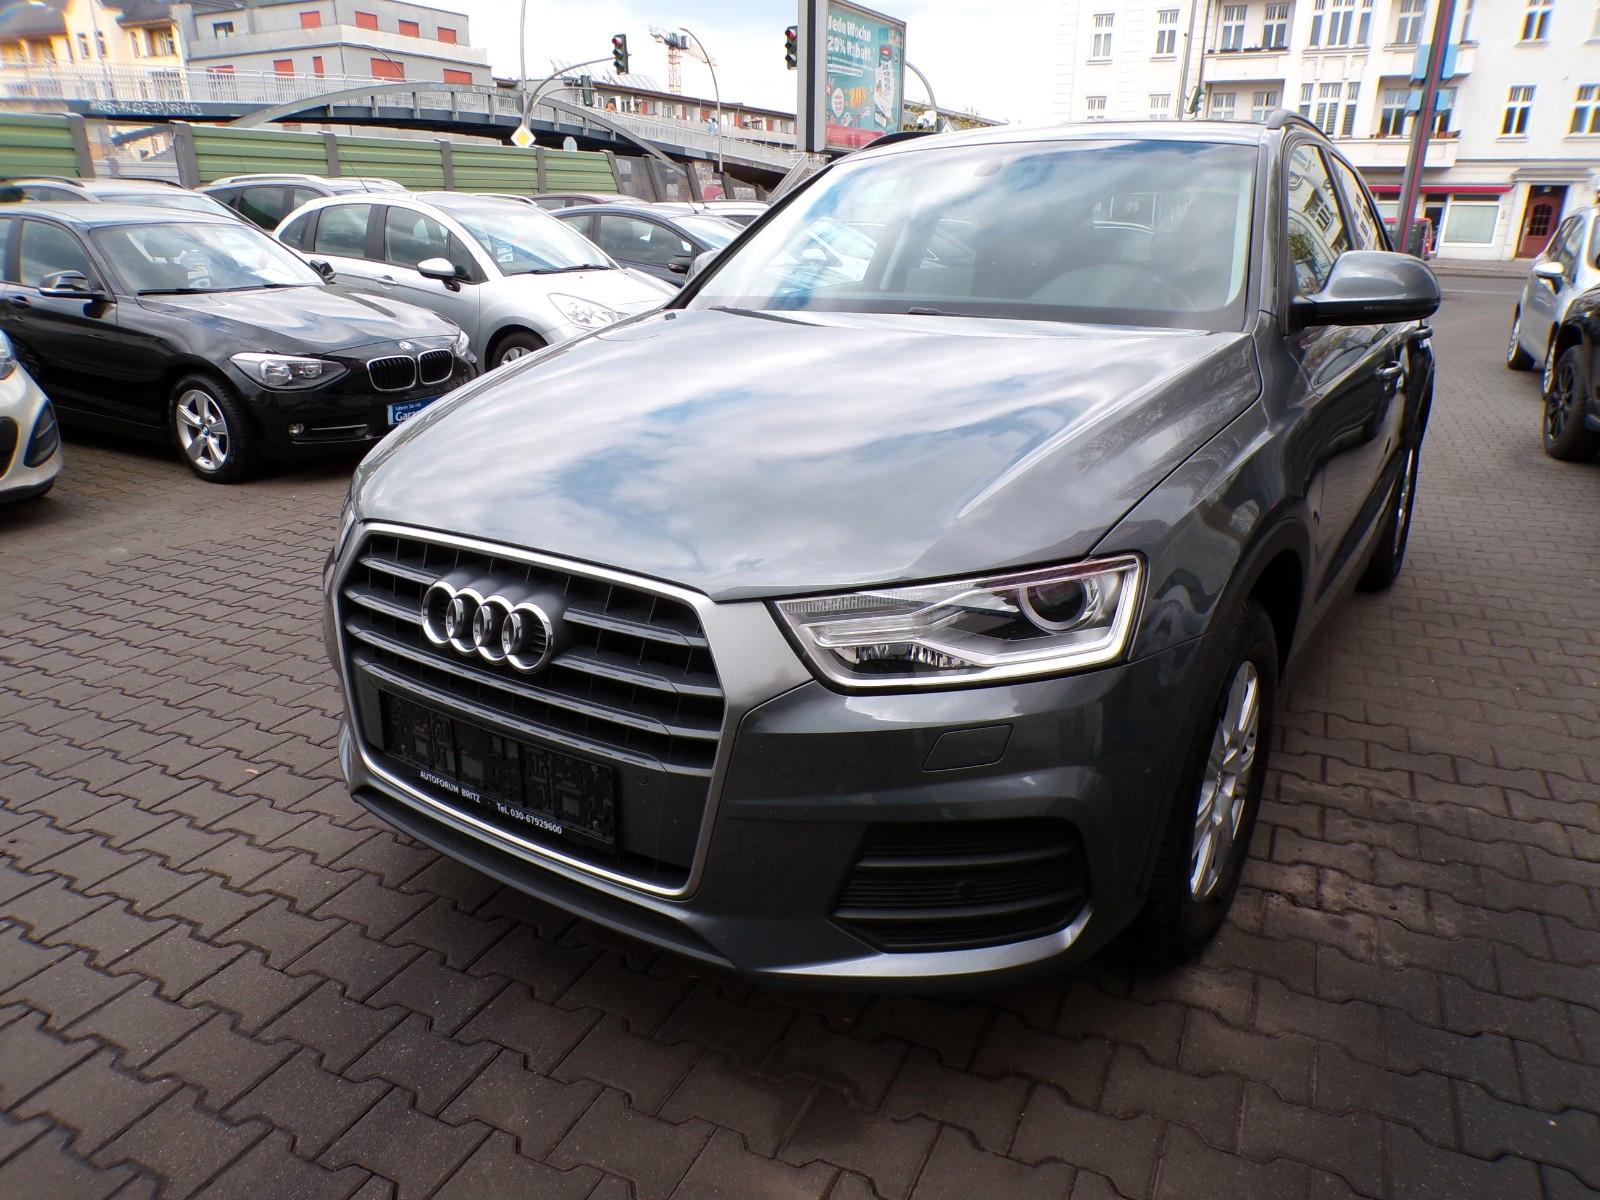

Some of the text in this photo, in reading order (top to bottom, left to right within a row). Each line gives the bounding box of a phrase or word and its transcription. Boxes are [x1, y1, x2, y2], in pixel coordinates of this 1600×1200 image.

[827, 15, 871, 42] Jede Woche
[827, 36, 845, 54] 20%
[420, 770, 459, 794] AUTOFORUM
[461, 788, 481, 803] BRITZ
[510, 808, 563, 834] 030-67929600
